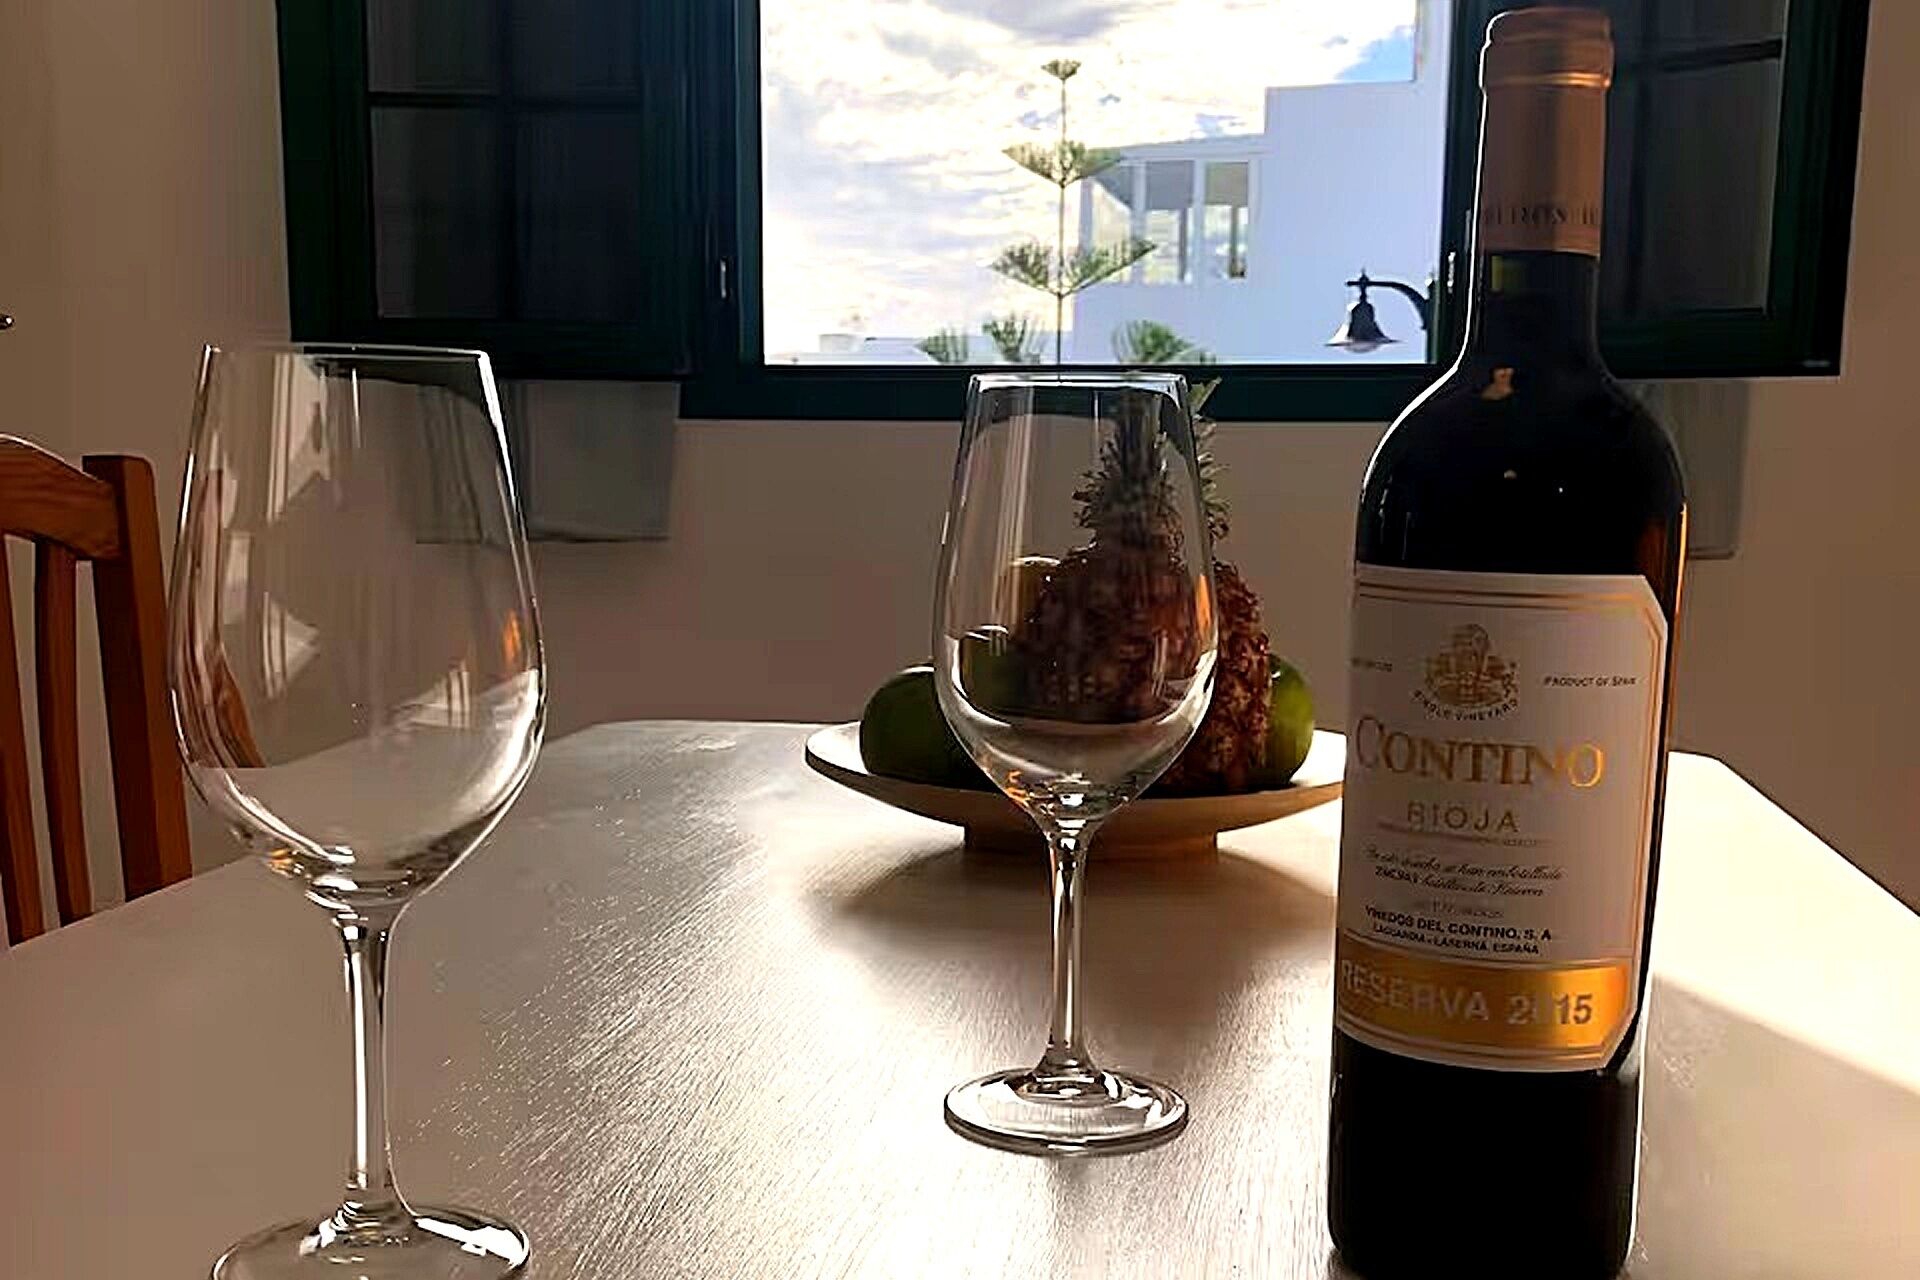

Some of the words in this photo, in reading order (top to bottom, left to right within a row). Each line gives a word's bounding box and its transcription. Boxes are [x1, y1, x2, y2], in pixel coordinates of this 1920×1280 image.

[1407, 801, 1519, 834] RIOJA
[1417, 917, 1445, 933] DEL
[1341, 959, 1490, 1022] RESERVA
